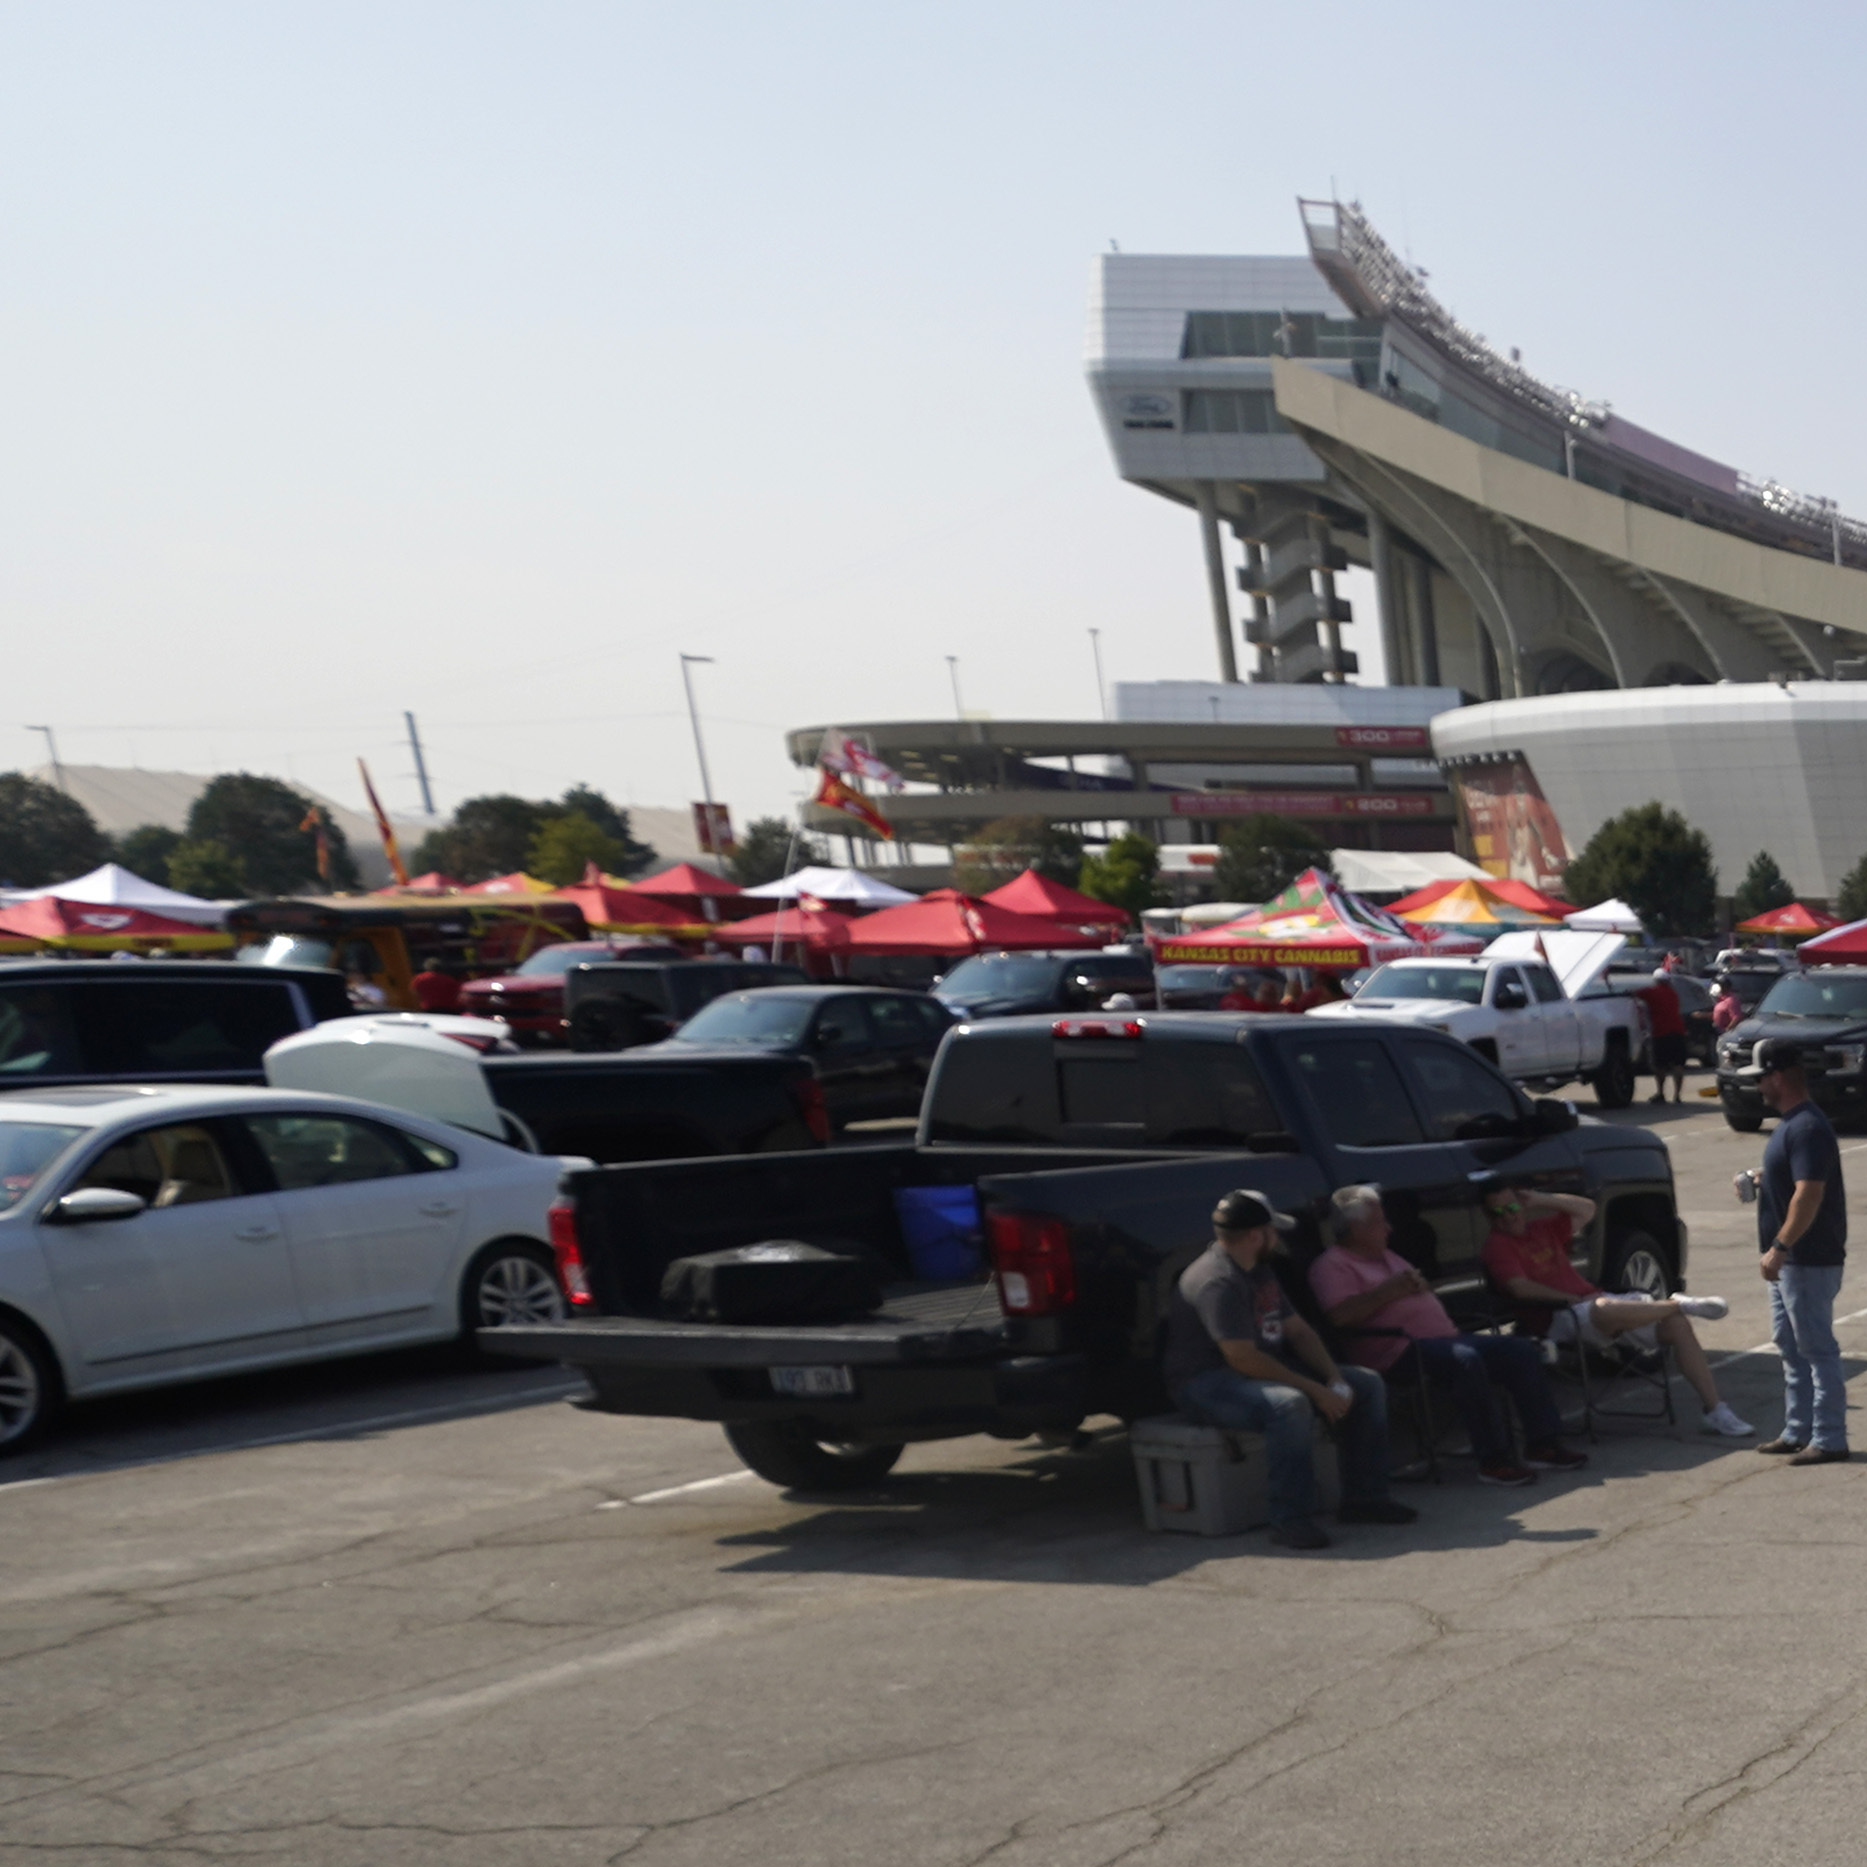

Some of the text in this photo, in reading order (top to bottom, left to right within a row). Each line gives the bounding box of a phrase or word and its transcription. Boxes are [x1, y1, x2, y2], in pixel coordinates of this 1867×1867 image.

[1349, 729, 1391, 743] 300
[1161, 944, 1229, 962] KANSAS
[1233, 946, 1272, 962] CITY
[1275, 948, 1360, 964] CANNABIS
